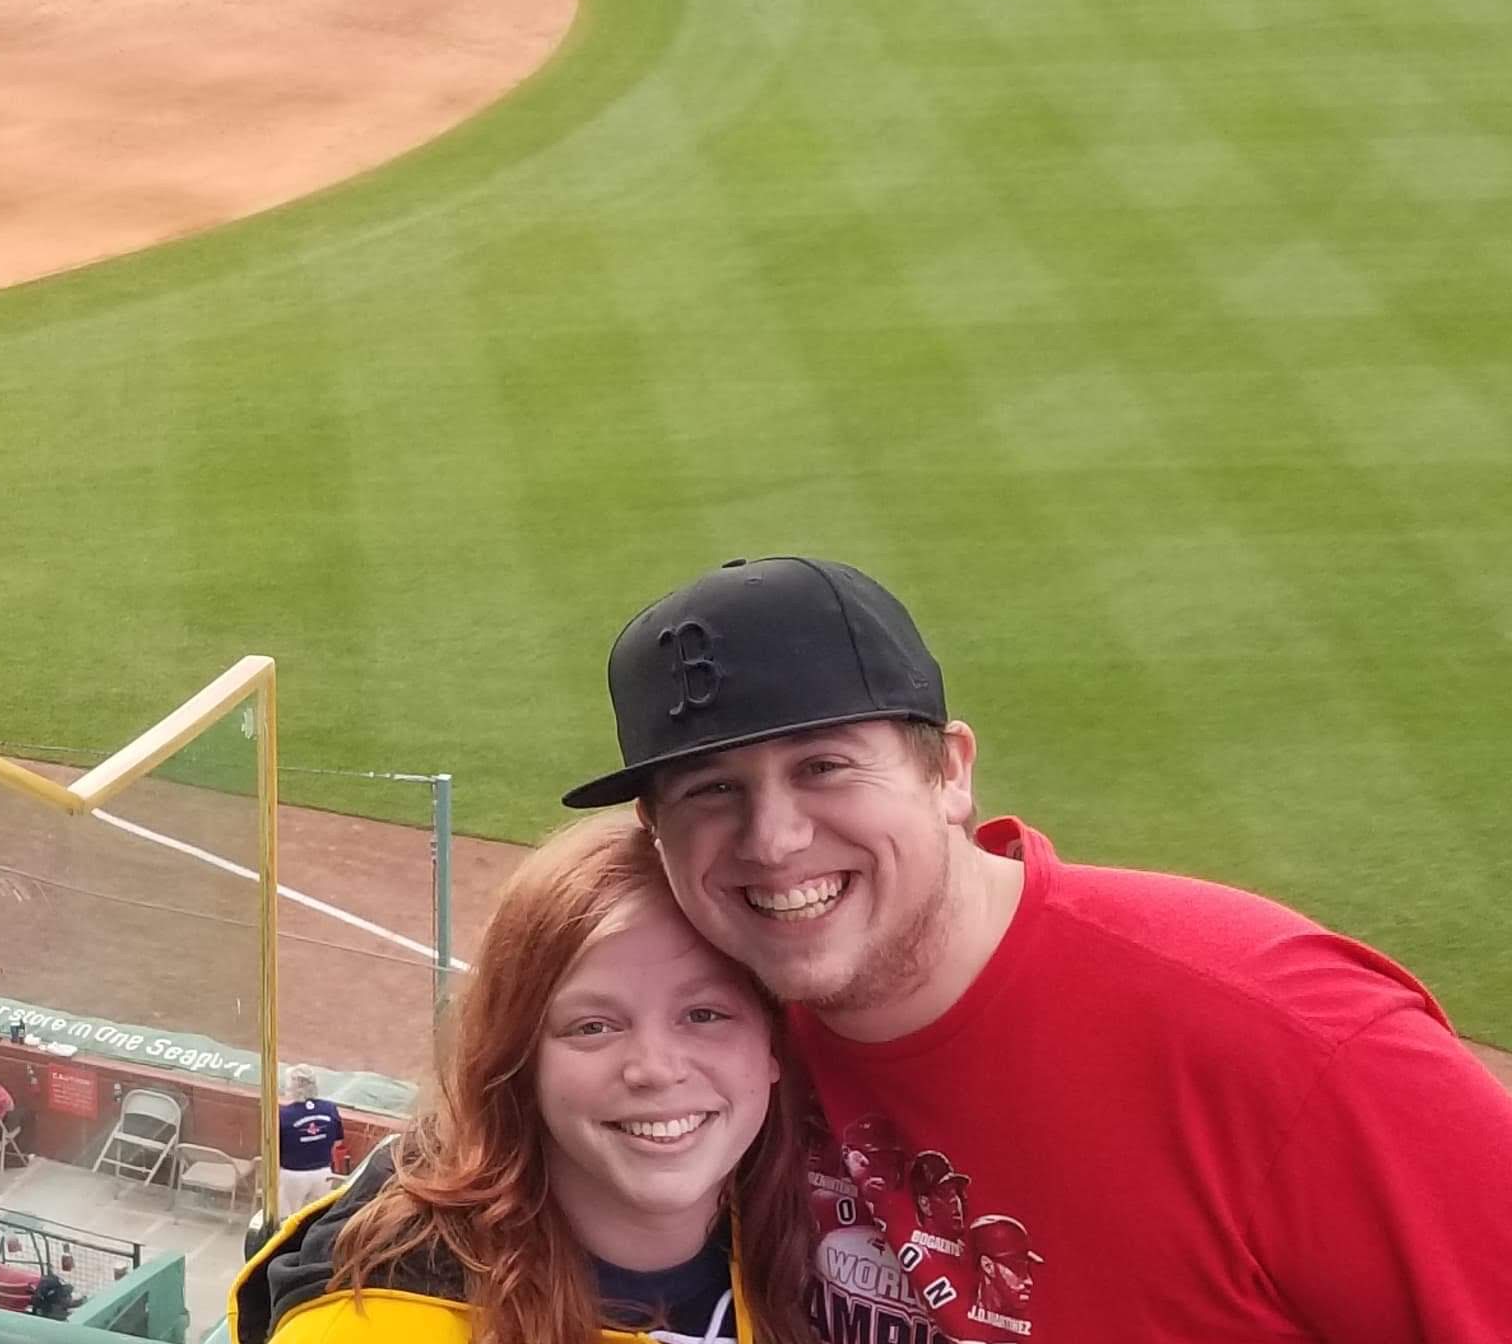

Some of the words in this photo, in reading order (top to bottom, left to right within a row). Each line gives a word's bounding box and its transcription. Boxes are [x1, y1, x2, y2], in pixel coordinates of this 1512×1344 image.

[658, 619, 725, 717] B
[8, 1006, 67, 1032] store
[68, 1015, 93, 1038] in
[93, 1021, 145, 1052] One
[826, 1246, 918, 1304] WORL
